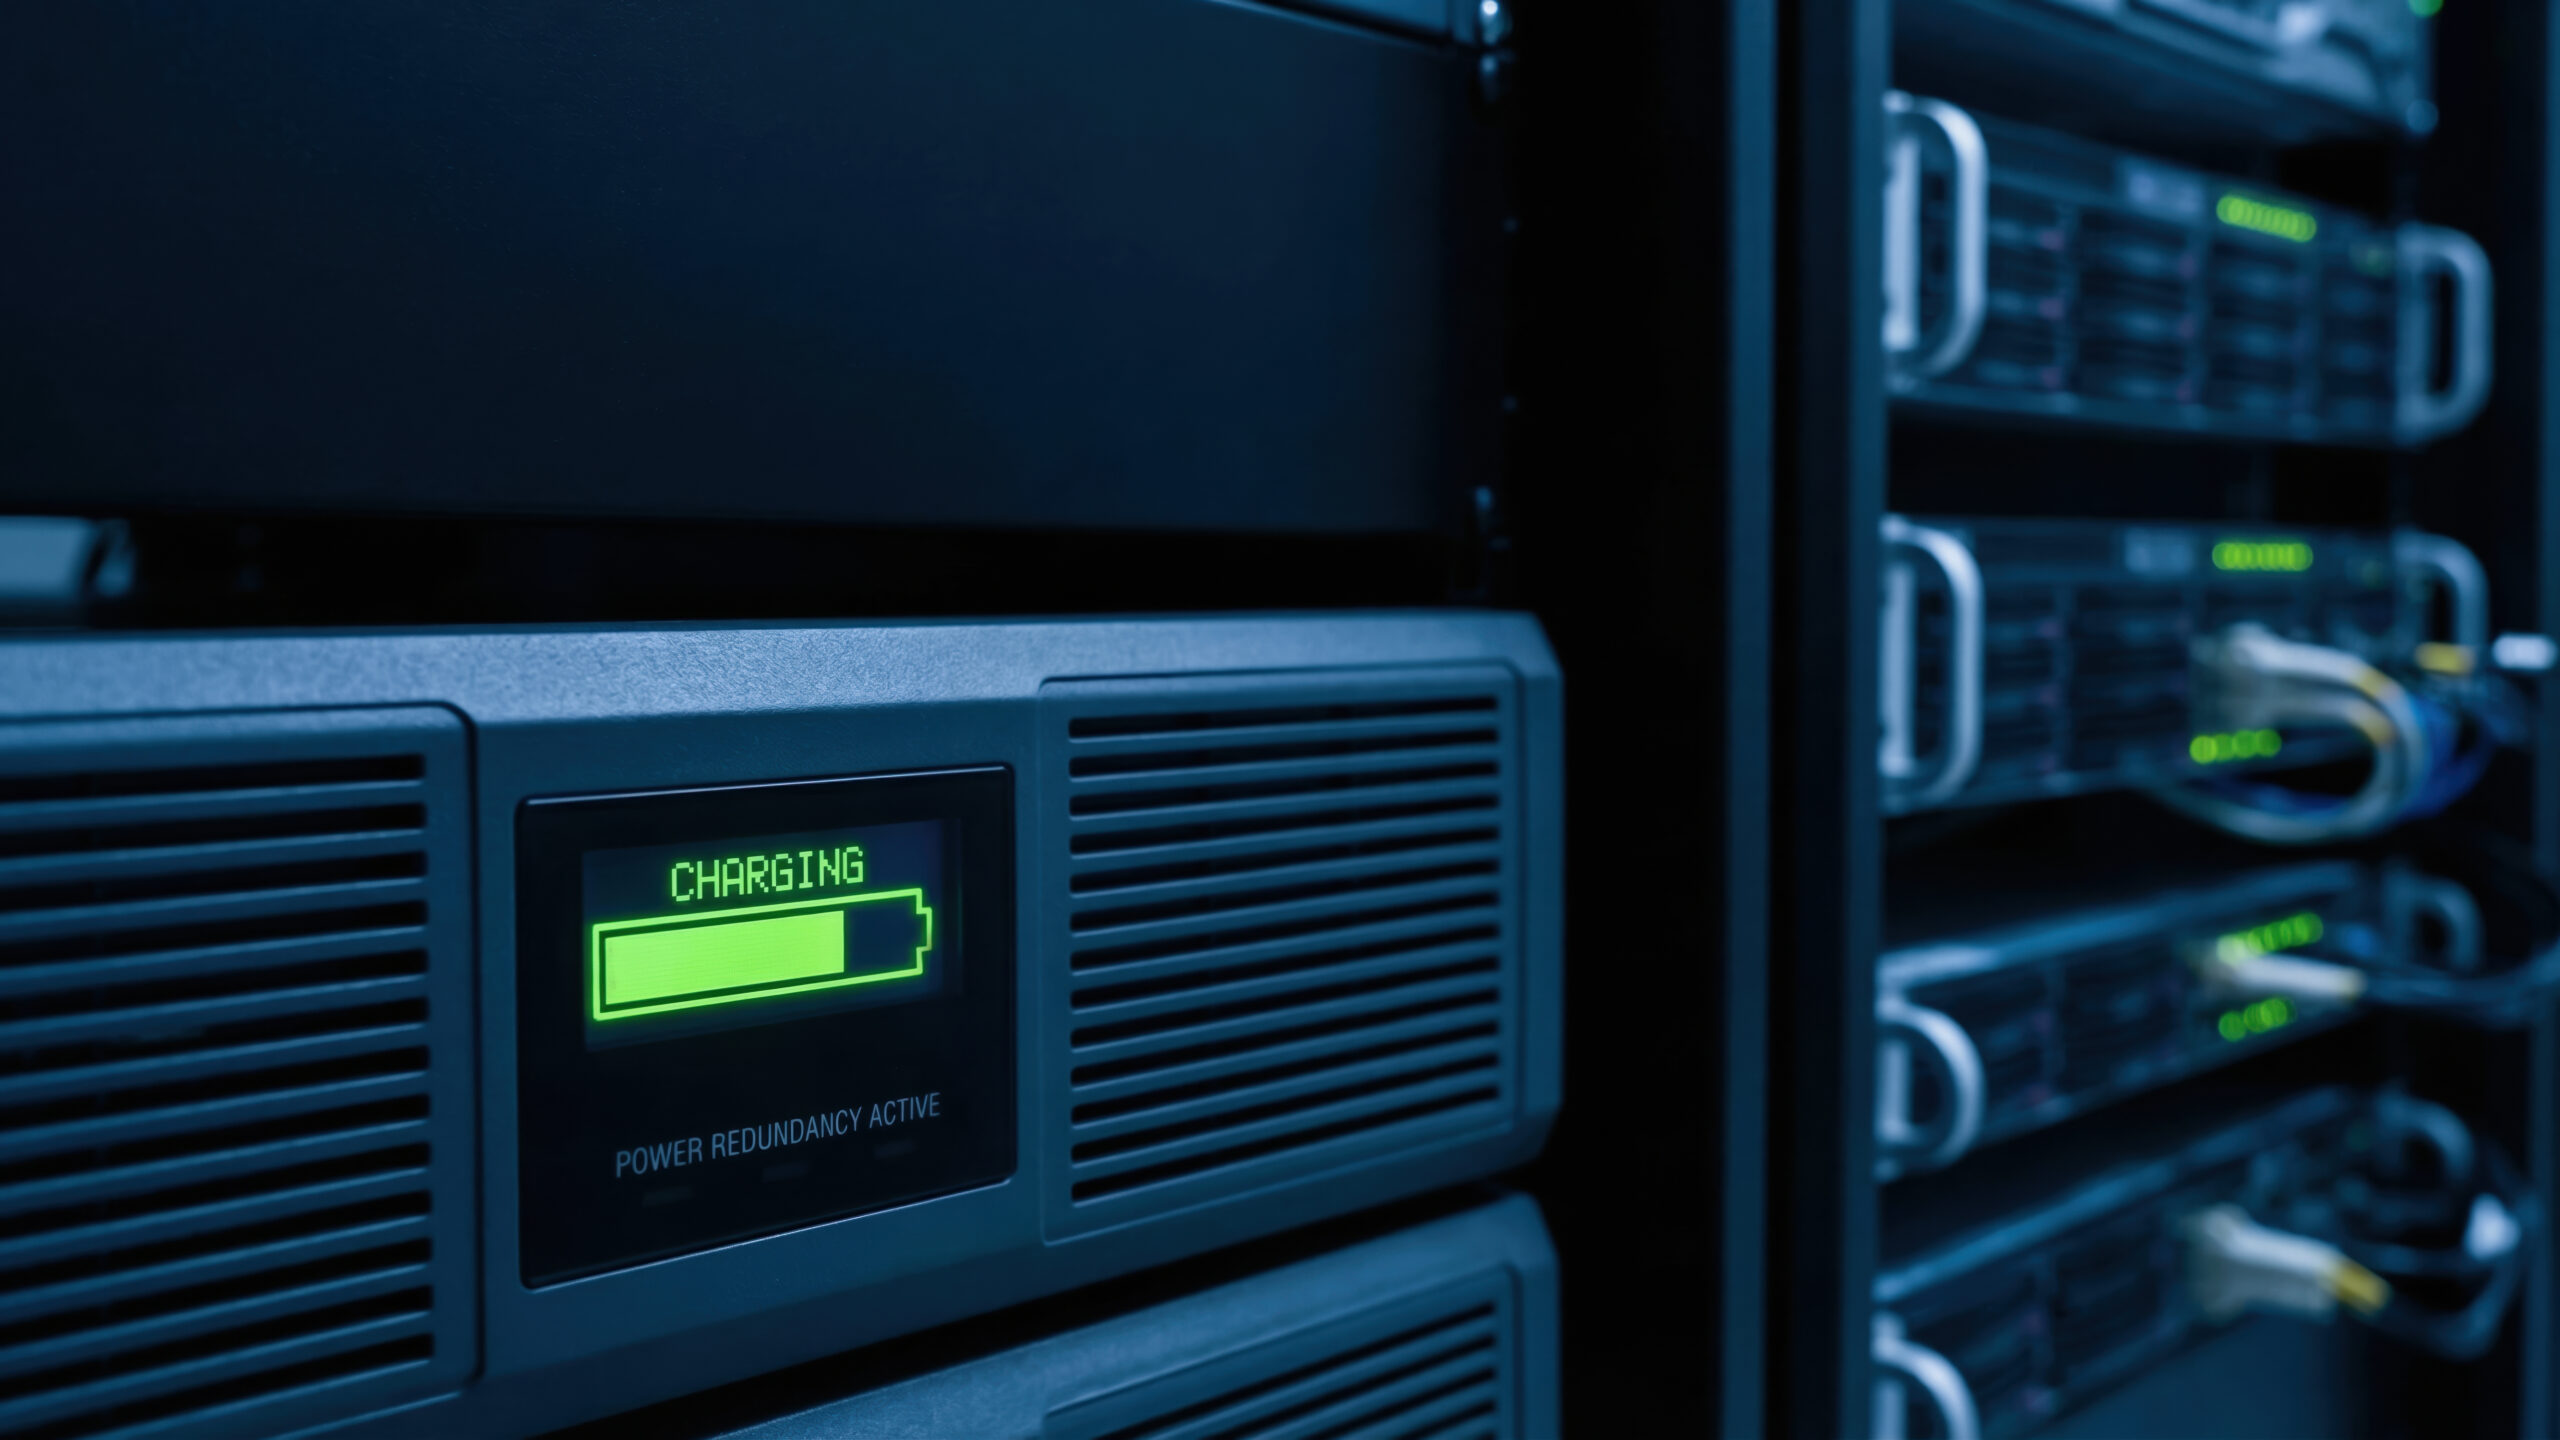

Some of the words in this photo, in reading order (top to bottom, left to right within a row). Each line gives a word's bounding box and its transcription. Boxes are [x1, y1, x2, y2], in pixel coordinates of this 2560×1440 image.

[671, 846, 864, 902] CHARGING
[615, 1137, 703, 1178] POWER
[712, 1106, 862, 1158] REDUNDANCY
[869, 1091, 942, 1129] ACTIVE
